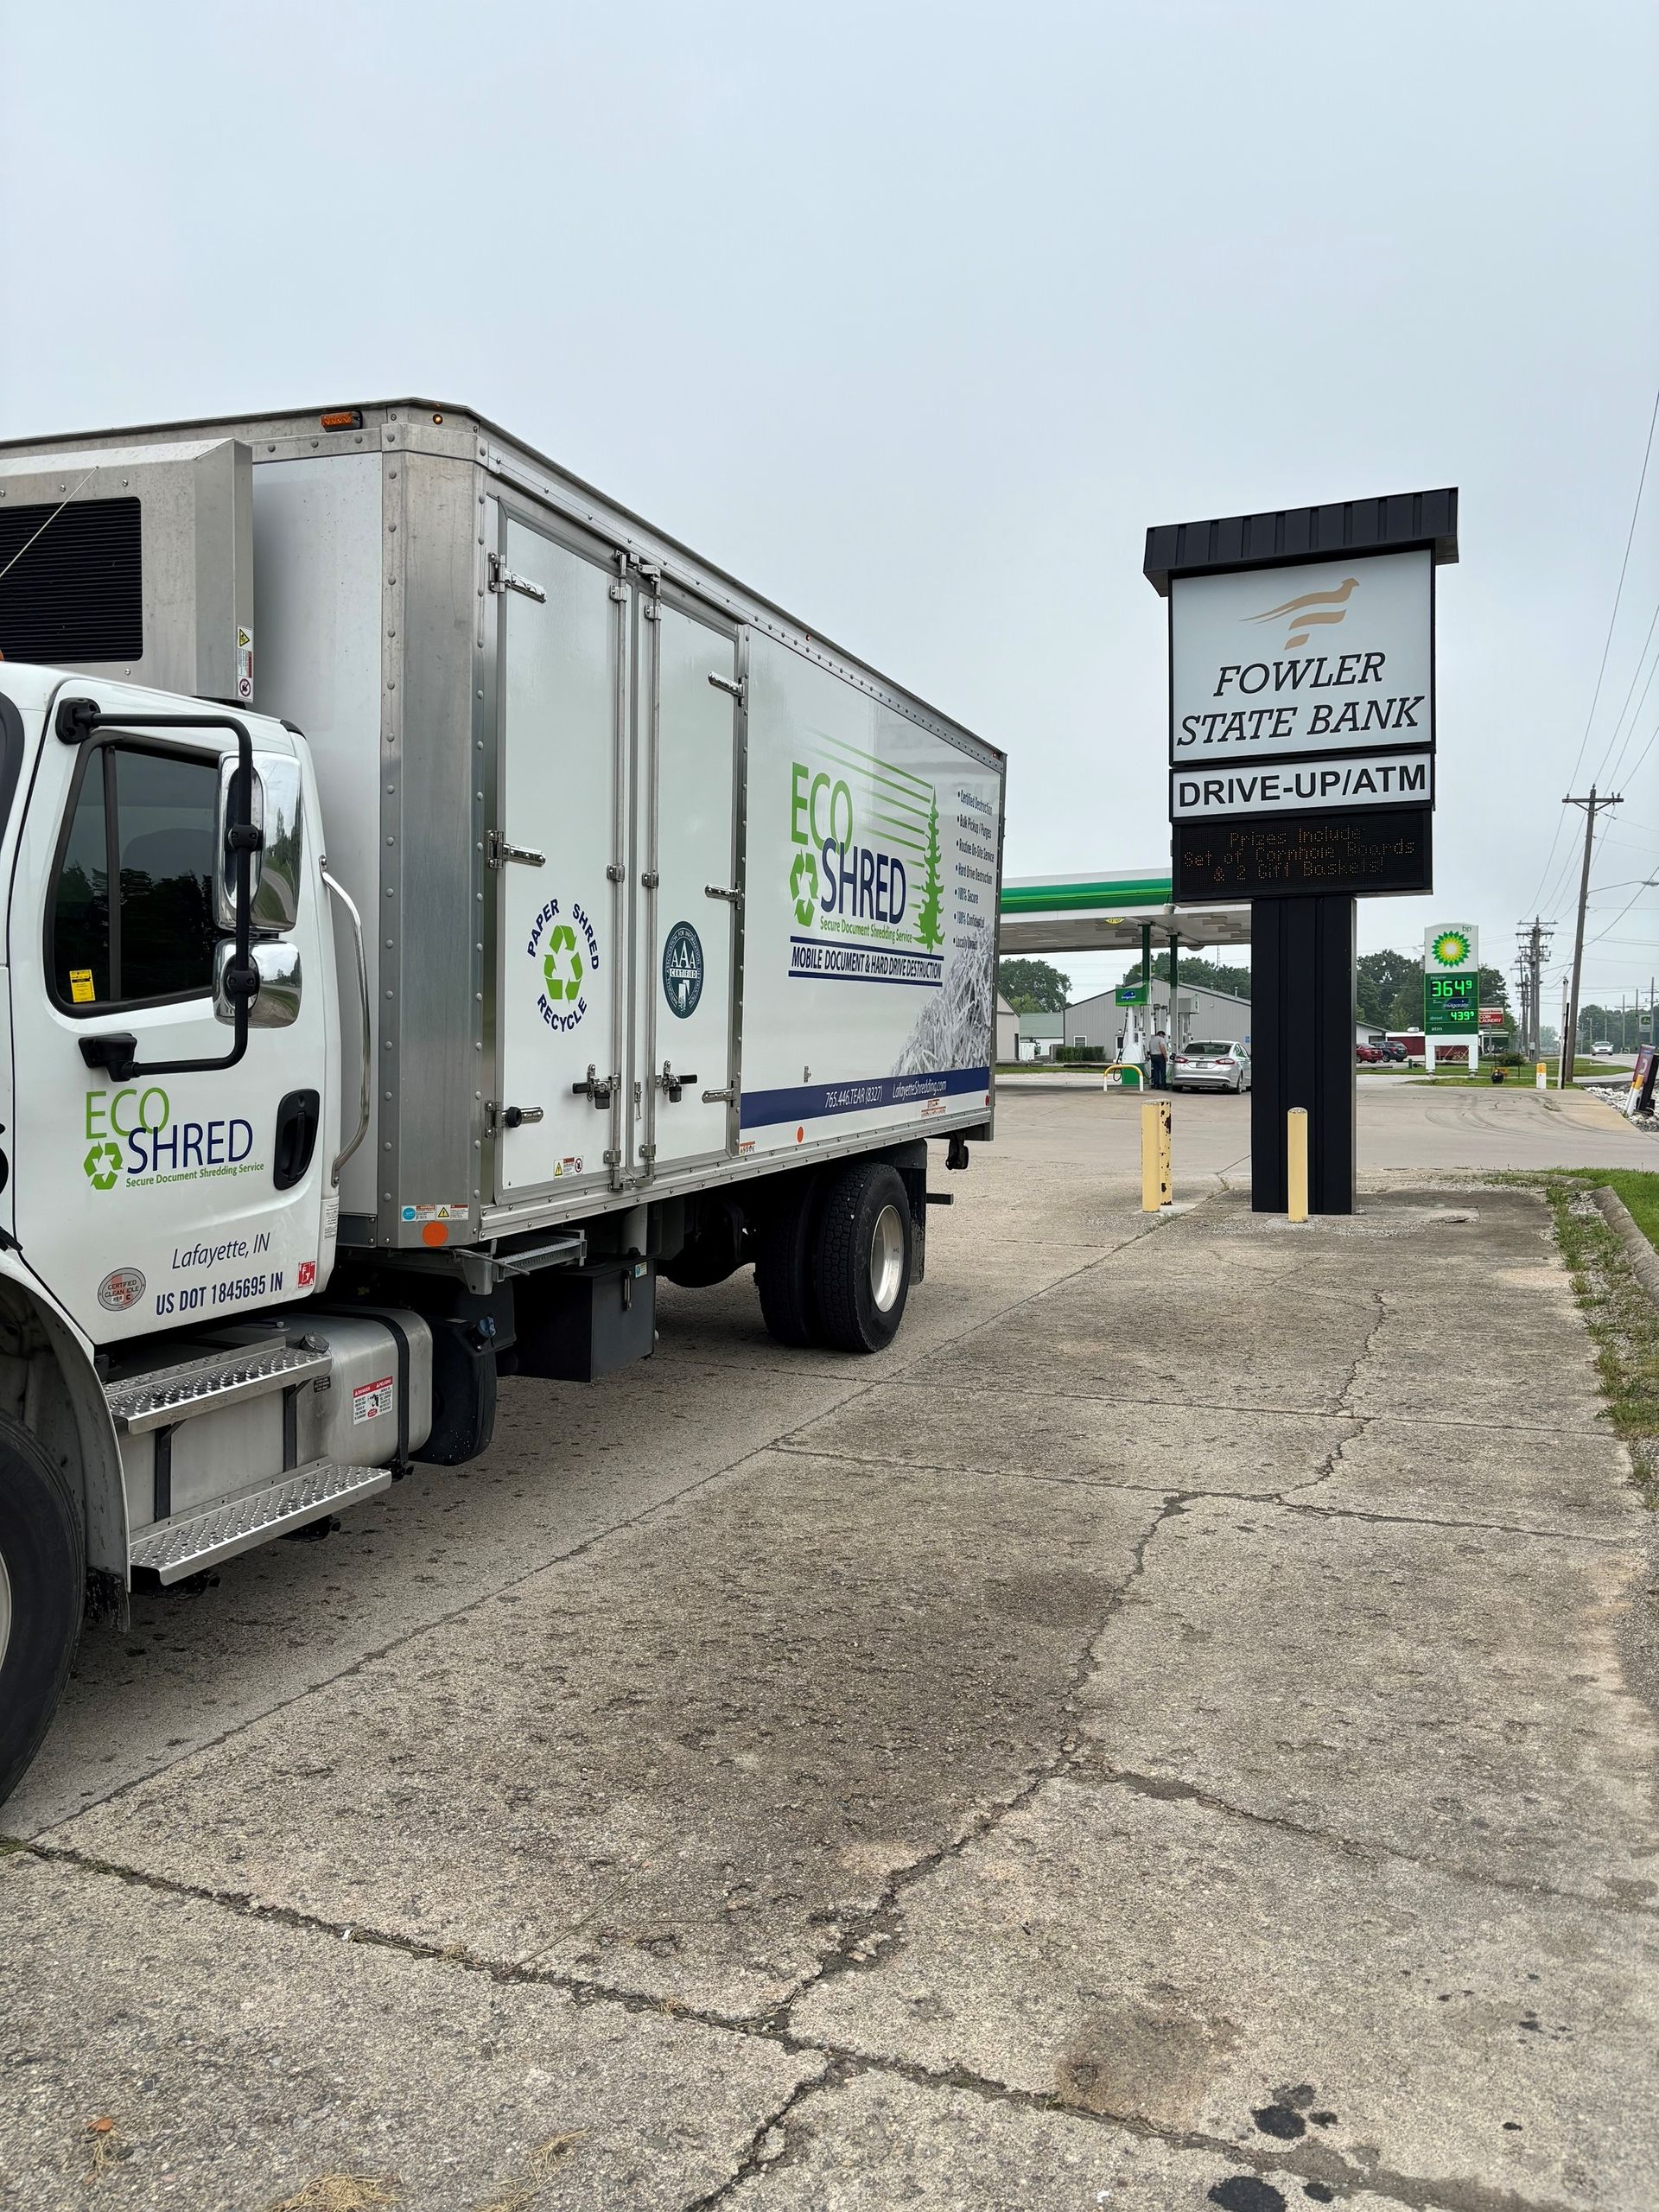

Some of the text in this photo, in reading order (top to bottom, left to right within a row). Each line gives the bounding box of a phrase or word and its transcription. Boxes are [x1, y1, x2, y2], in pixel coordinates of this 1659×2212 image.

[1213, 652, 1386, 697] FOWLER
[1176, 696, 1425, 747] STATE BANK
[1179, 764, 1426, 807] DRIVE-UP/ATM
[791, 761, 853, 855] ECO
[1184, 838, 1415, 867] Set of Cornhole Boards
[1230, 831, 1287, 848] Prizes
[821, 837, 906, 925] SHRED
[1213, 866, 1225, 882] &
[1236, 865, 1247, 880] 2
[1258, 862, 1290, 879] Gift
[527, 899, 600, 969] PAPER SHRED
[820, 915, 913, 944] Secure Document Shredding Service
[671, 940, 696, 969] AAA
[791, 946, 942, 980] MOBILE DOCUMENT & HARD DRIVE DESTRUCTION
[671, 969, 696, 978] CERTIFIED
[537, 994, 588, 1033] RECYCLE
[824, 1085, 883, 1109] 765.446.TEAR (8327)
[892, 1079, 947, 1101] LafayetteShredding.com
[86, 1087, 169, 1140] ECO
[127, 1119, 253, 1174] SHRED
[125, 1162, 264, 1188] Secure Document Shredding Service
[172, 1232, 270, 1269] Lafayette, IN
[105, 1289, 124, 1298] CLEAN
[107, 1280, 137, 1290] CERTIFIED
[156, 1271, 283, 1316] US DOT 1845695 IN
